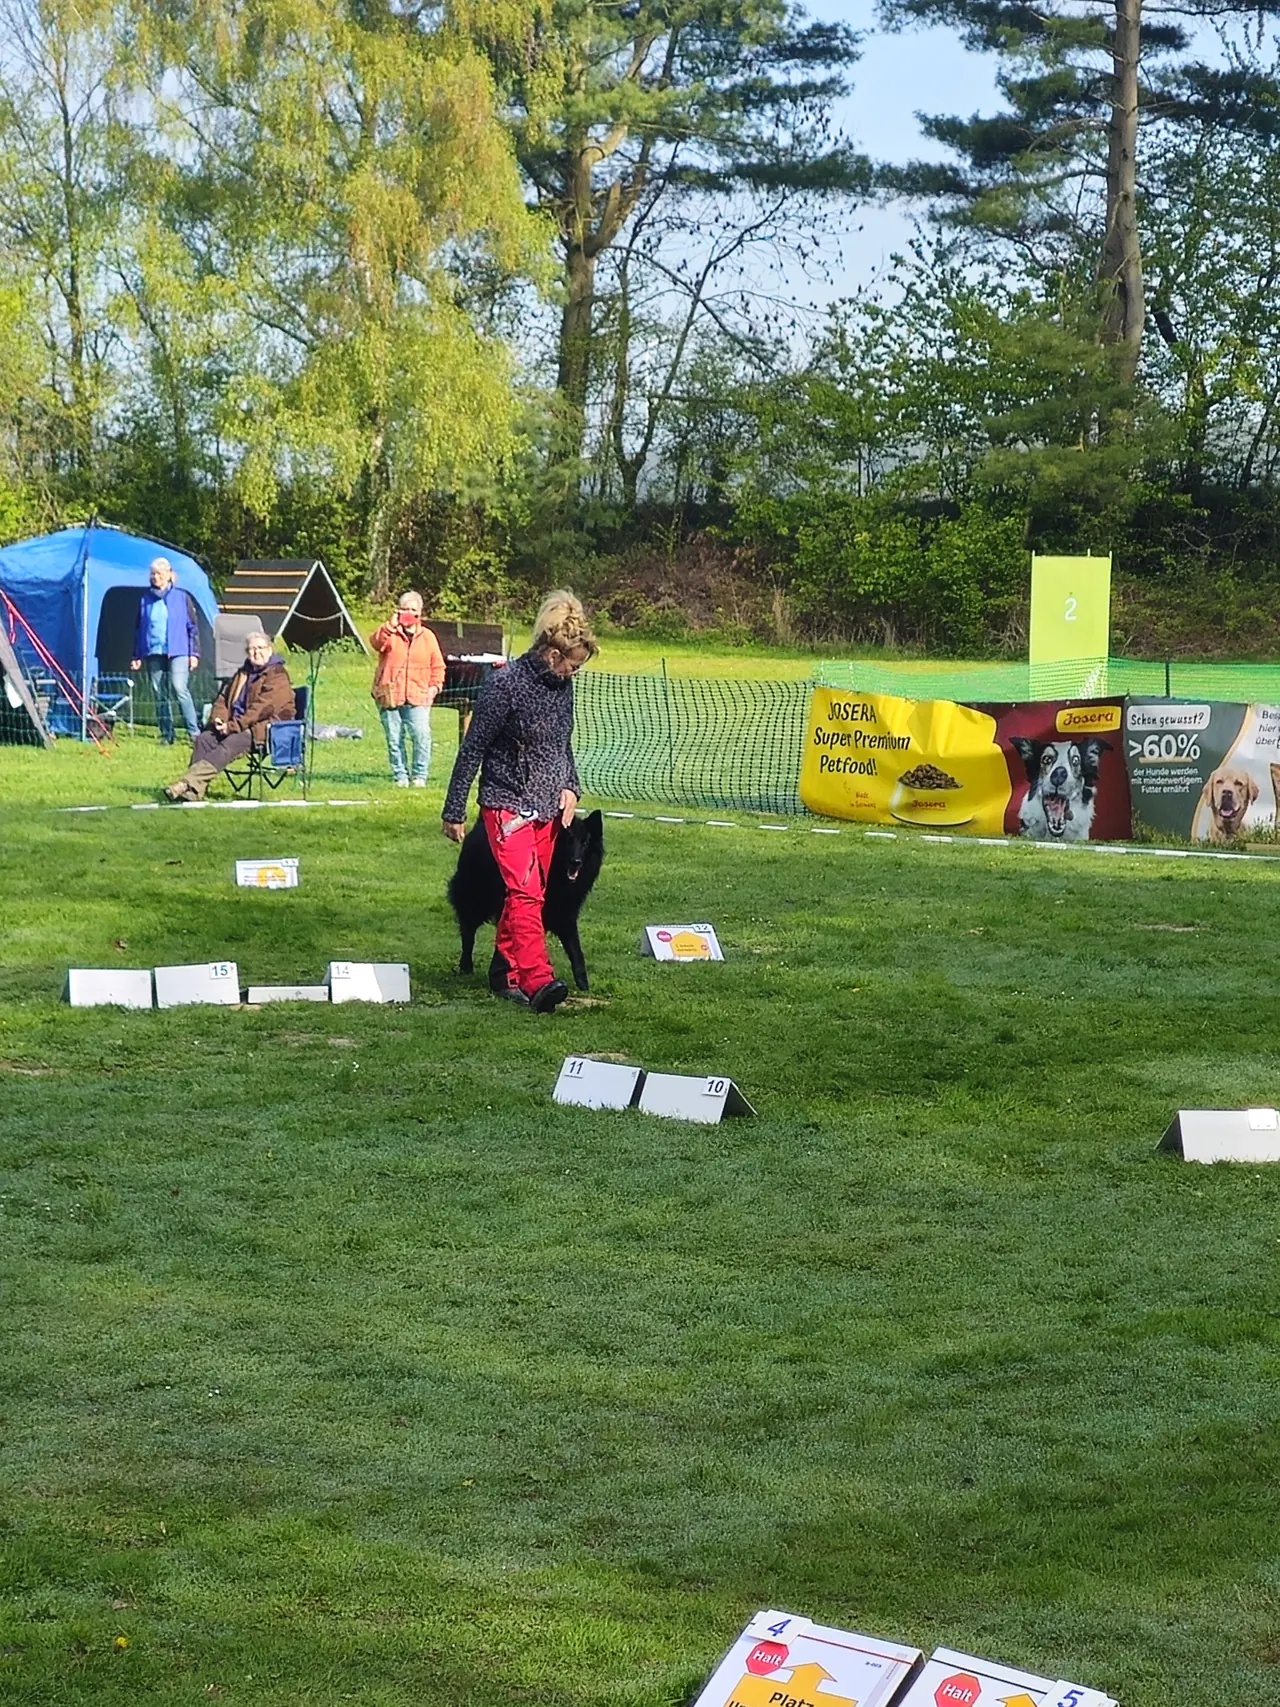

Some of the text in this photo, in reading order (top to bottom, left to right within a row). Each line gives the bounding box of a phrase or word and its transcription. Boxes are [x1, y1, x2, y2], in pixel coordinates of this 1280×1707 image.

[1064, 597, 1078, 621] 2
[828, 702, 877, 723] JOSERA
[1063, 712, 1114, 726] Josera
[1131, 712, 1205, 727] Schon gewusst?
[813, 726, 911, 750] Super Premium
[1128, 733, 1201, 760] >60%
[820, 754, 878, 776] Petfood!
[1146, 768, 1170, 776] Hunde
[1171, 767, 1199, 775] werden
[211, 965, 229, 977] 15
[334, 965, 350, 975] 14
[569, 1060, 585, 1075] 11
[707, 1080, 725, 1094] 10
[767, 1618, 792, 1637] 4
[752, 1650, 782, 1665] Halt
[941, 1683, 973, 1703] Halt
[1057, 1688, 1085, 1707] 5
